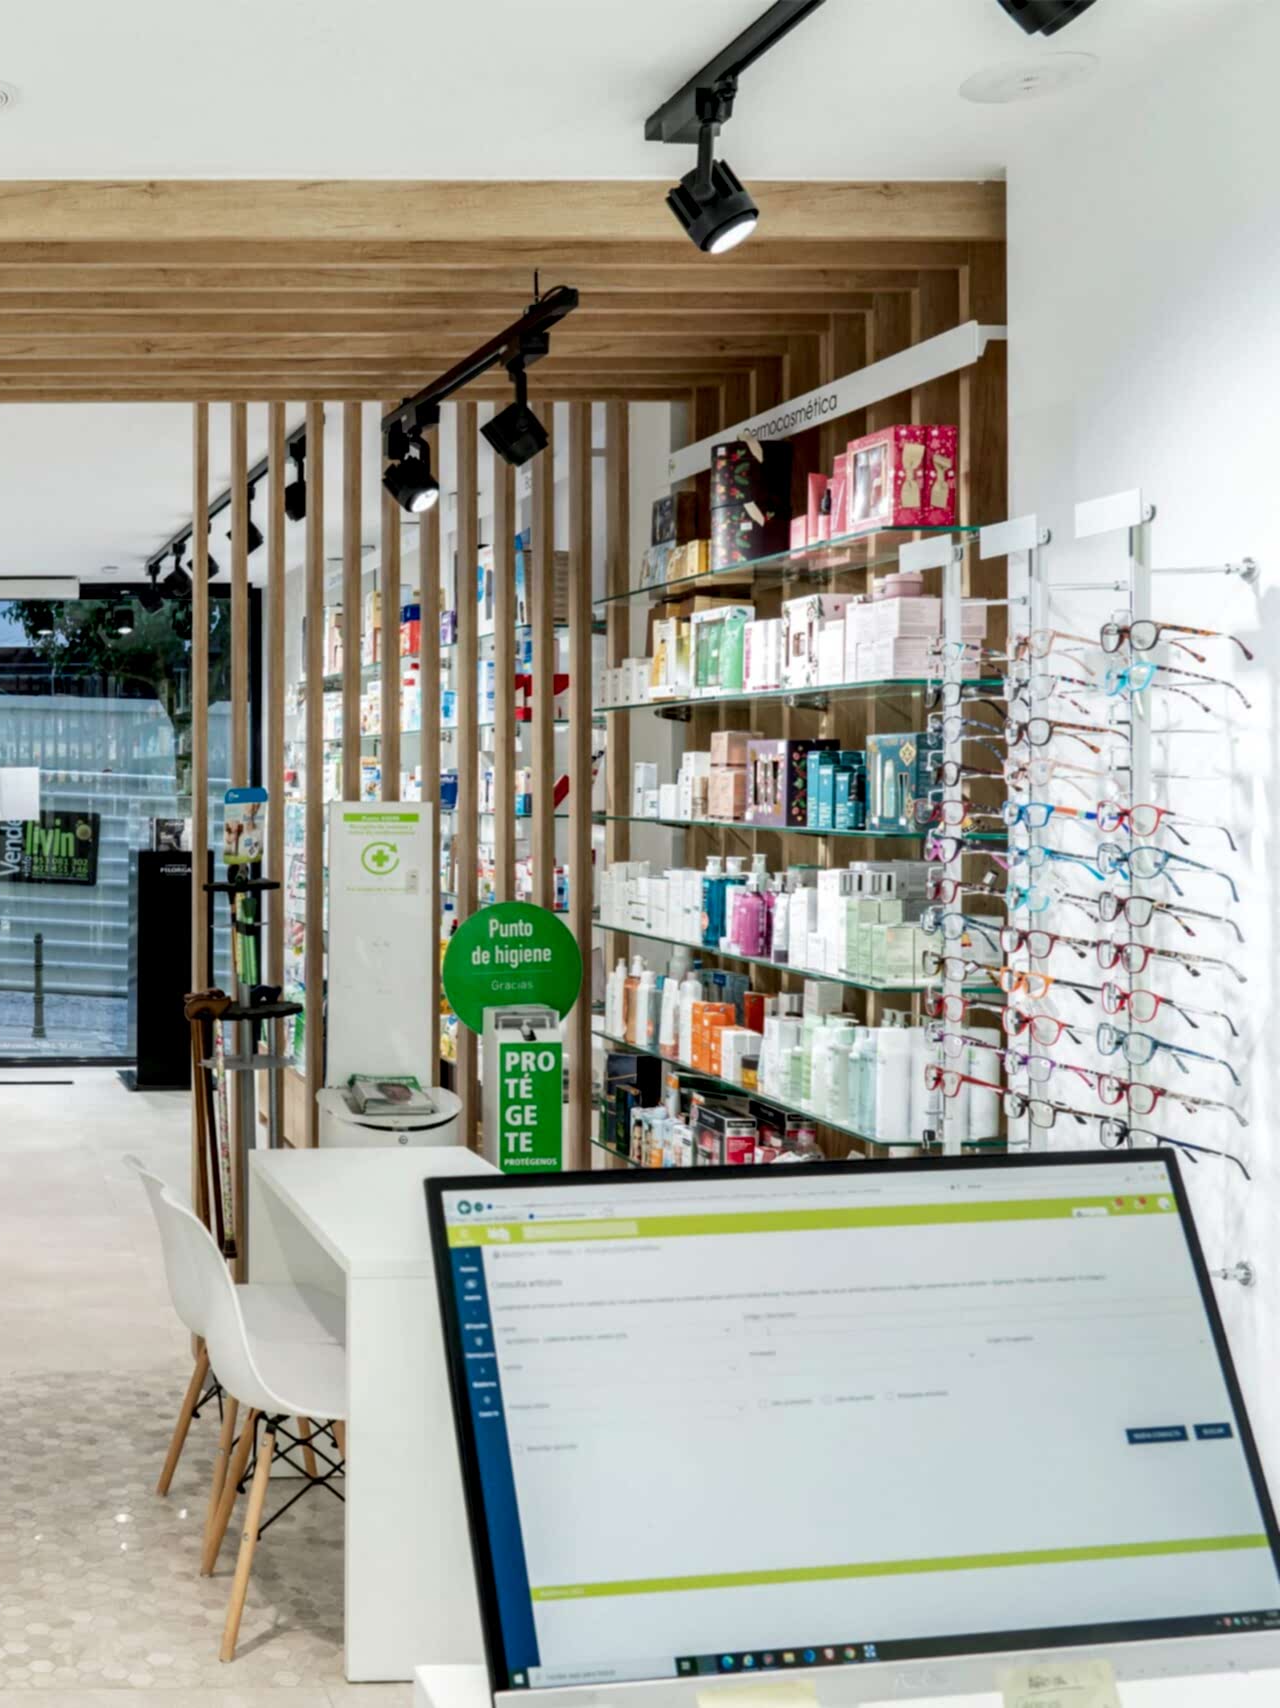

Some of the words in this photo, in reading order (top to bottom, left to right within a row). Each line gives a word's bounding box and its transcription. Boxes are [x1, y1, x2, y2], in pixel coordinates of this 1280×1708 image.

[0, 817, 23, 876] Vende
[489, 918, 533, 938] Punto
[472, 946, 490, 965] de
[495, 944, 552, 968] higiene
[491, 980, 533, 991] Gracias
[505, 1051, 555, 1072] PRO
[504, 1073, 533, 1098] TÉ
[505, 1105, 537, 1126] GE
[504, 1132, 533, 1152] TE
